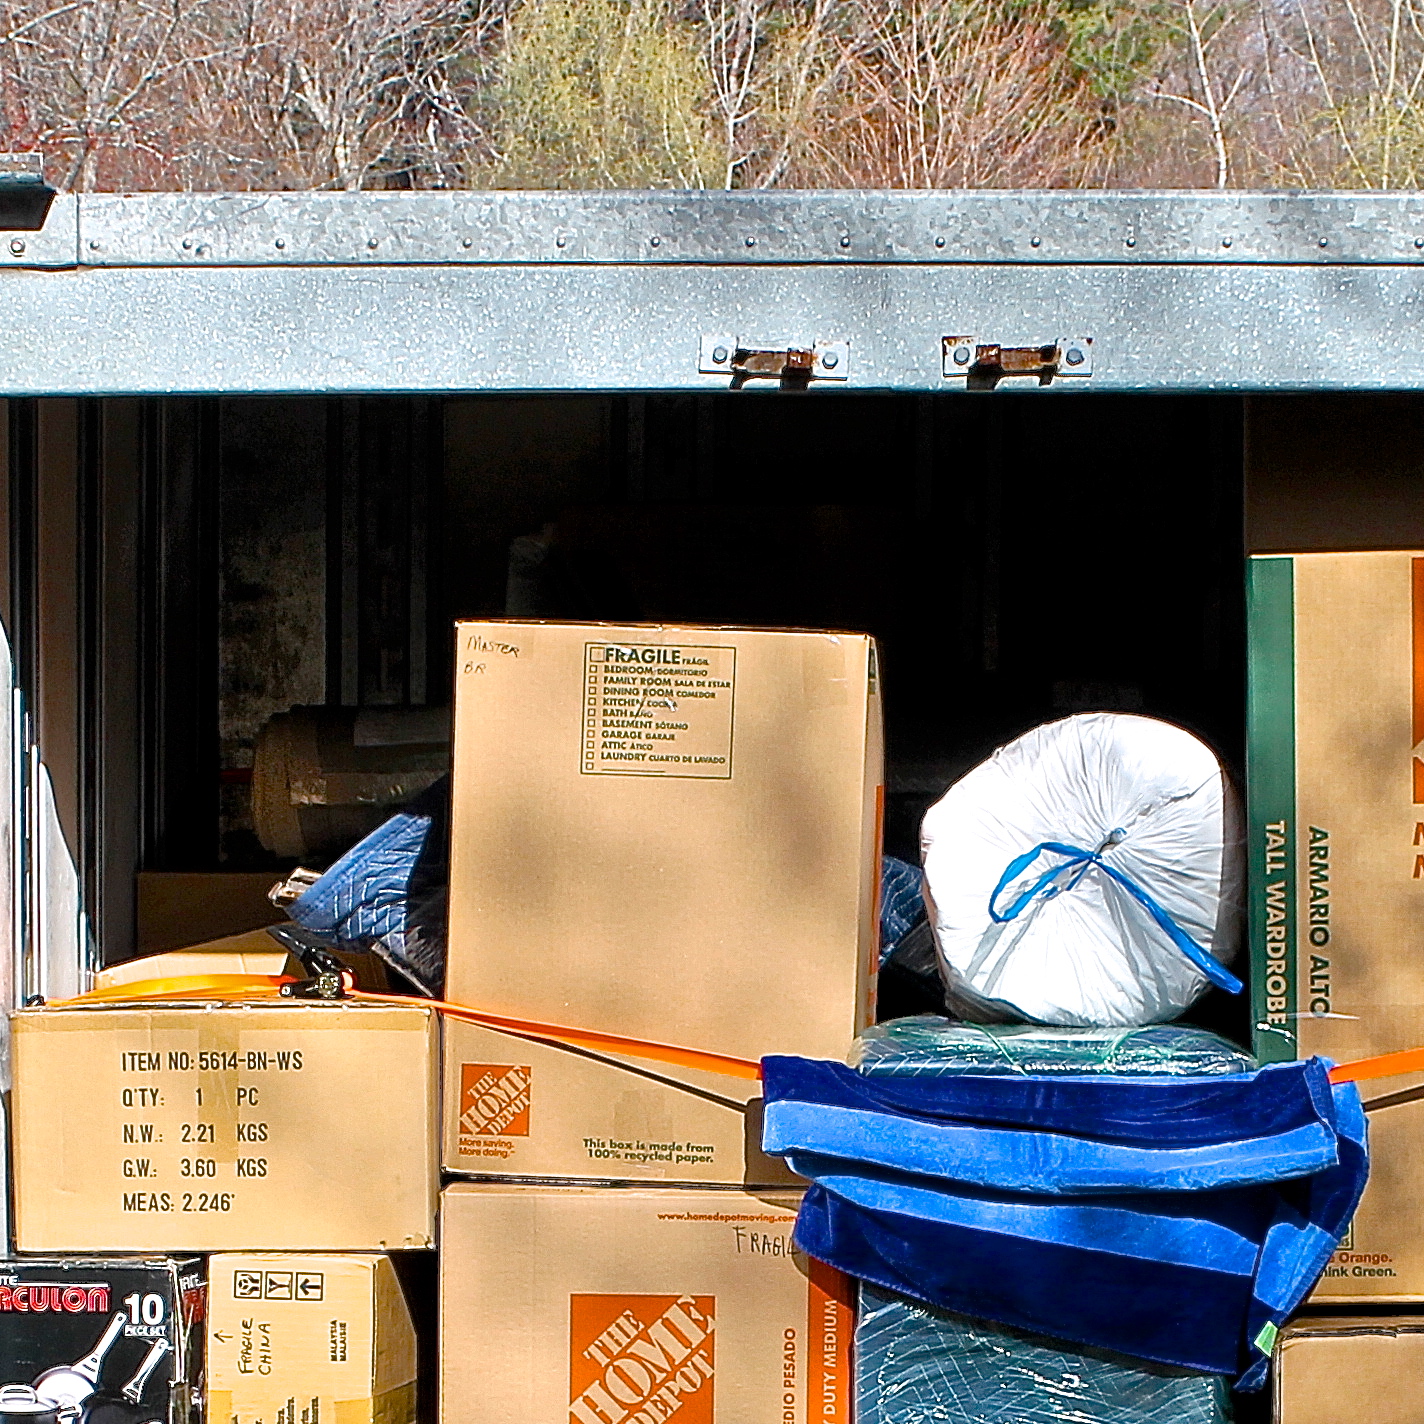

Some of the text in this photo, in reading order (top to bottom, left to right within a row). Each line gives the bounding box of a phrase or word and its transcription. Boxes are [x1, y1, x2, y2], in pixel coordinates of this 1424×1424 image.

[468, 636, 520, 658] MASTER
[605, 648, 680, 664] FRAGILE
[604, 665, 653, 675] BEDROOM
[603, 676, 637, 685] FAMILY
[640, 678, 671, 686] ROOM
[603, 687, 716, 698] DINING ROOM COMEDOR
[603, 697, 643, 706] KITCHEN
[603, 709, 627, 717] BATH
[602, 720, 688, 730] BASEMENT SÓTANO
[602, 730, 642, 740] GARAGE
[601, 741, 626, 749] ATTIC
[601, 752, 725, 763] LAUNDRY CUARTO DE LAVADO
[1265, 820, 1288, 1025] TALL WARDROBE
[1308, 825, 1331, 1019] ARMARIO ALTO
[122, 1050, 303, 1073] ITEM NO: 5614-BN-WS
[468, 1071, 497, 1099] THE
[123, 1087, 259, 1108] Q'TY: 1 PC
[460, 1065, 531, 1135] HOME
[486, 1091, 530, 1136] DEPOT
[123, 1123, 268, 1144] N.W.: 2.21 KGS
[459, 1137, 514, 1149] More saving.
[459, 1147, 510, 1159] More doing.
[583, 1138, 714, 1153] This box is made from
[588, 1149, 714, 1164] 100% recycled paper.
[181, 1158, 216, 1179] 3.60
[237, 1158, 268, 1177] KGS
[123, 1193, 175, 1213] MEAS:
[125, 1293, 165, 1326] 10
[583, 1309, 644, 1369] THE
[824, 1299, 838, 1368] MEDIUM
[237, 1317, 254, 1375] FRAGILE
[258, 1323, 271, 1376] CHINA
[784, 1327, 796, 1385] PESADO
[823, 1371, 836, 1417] DUTY
